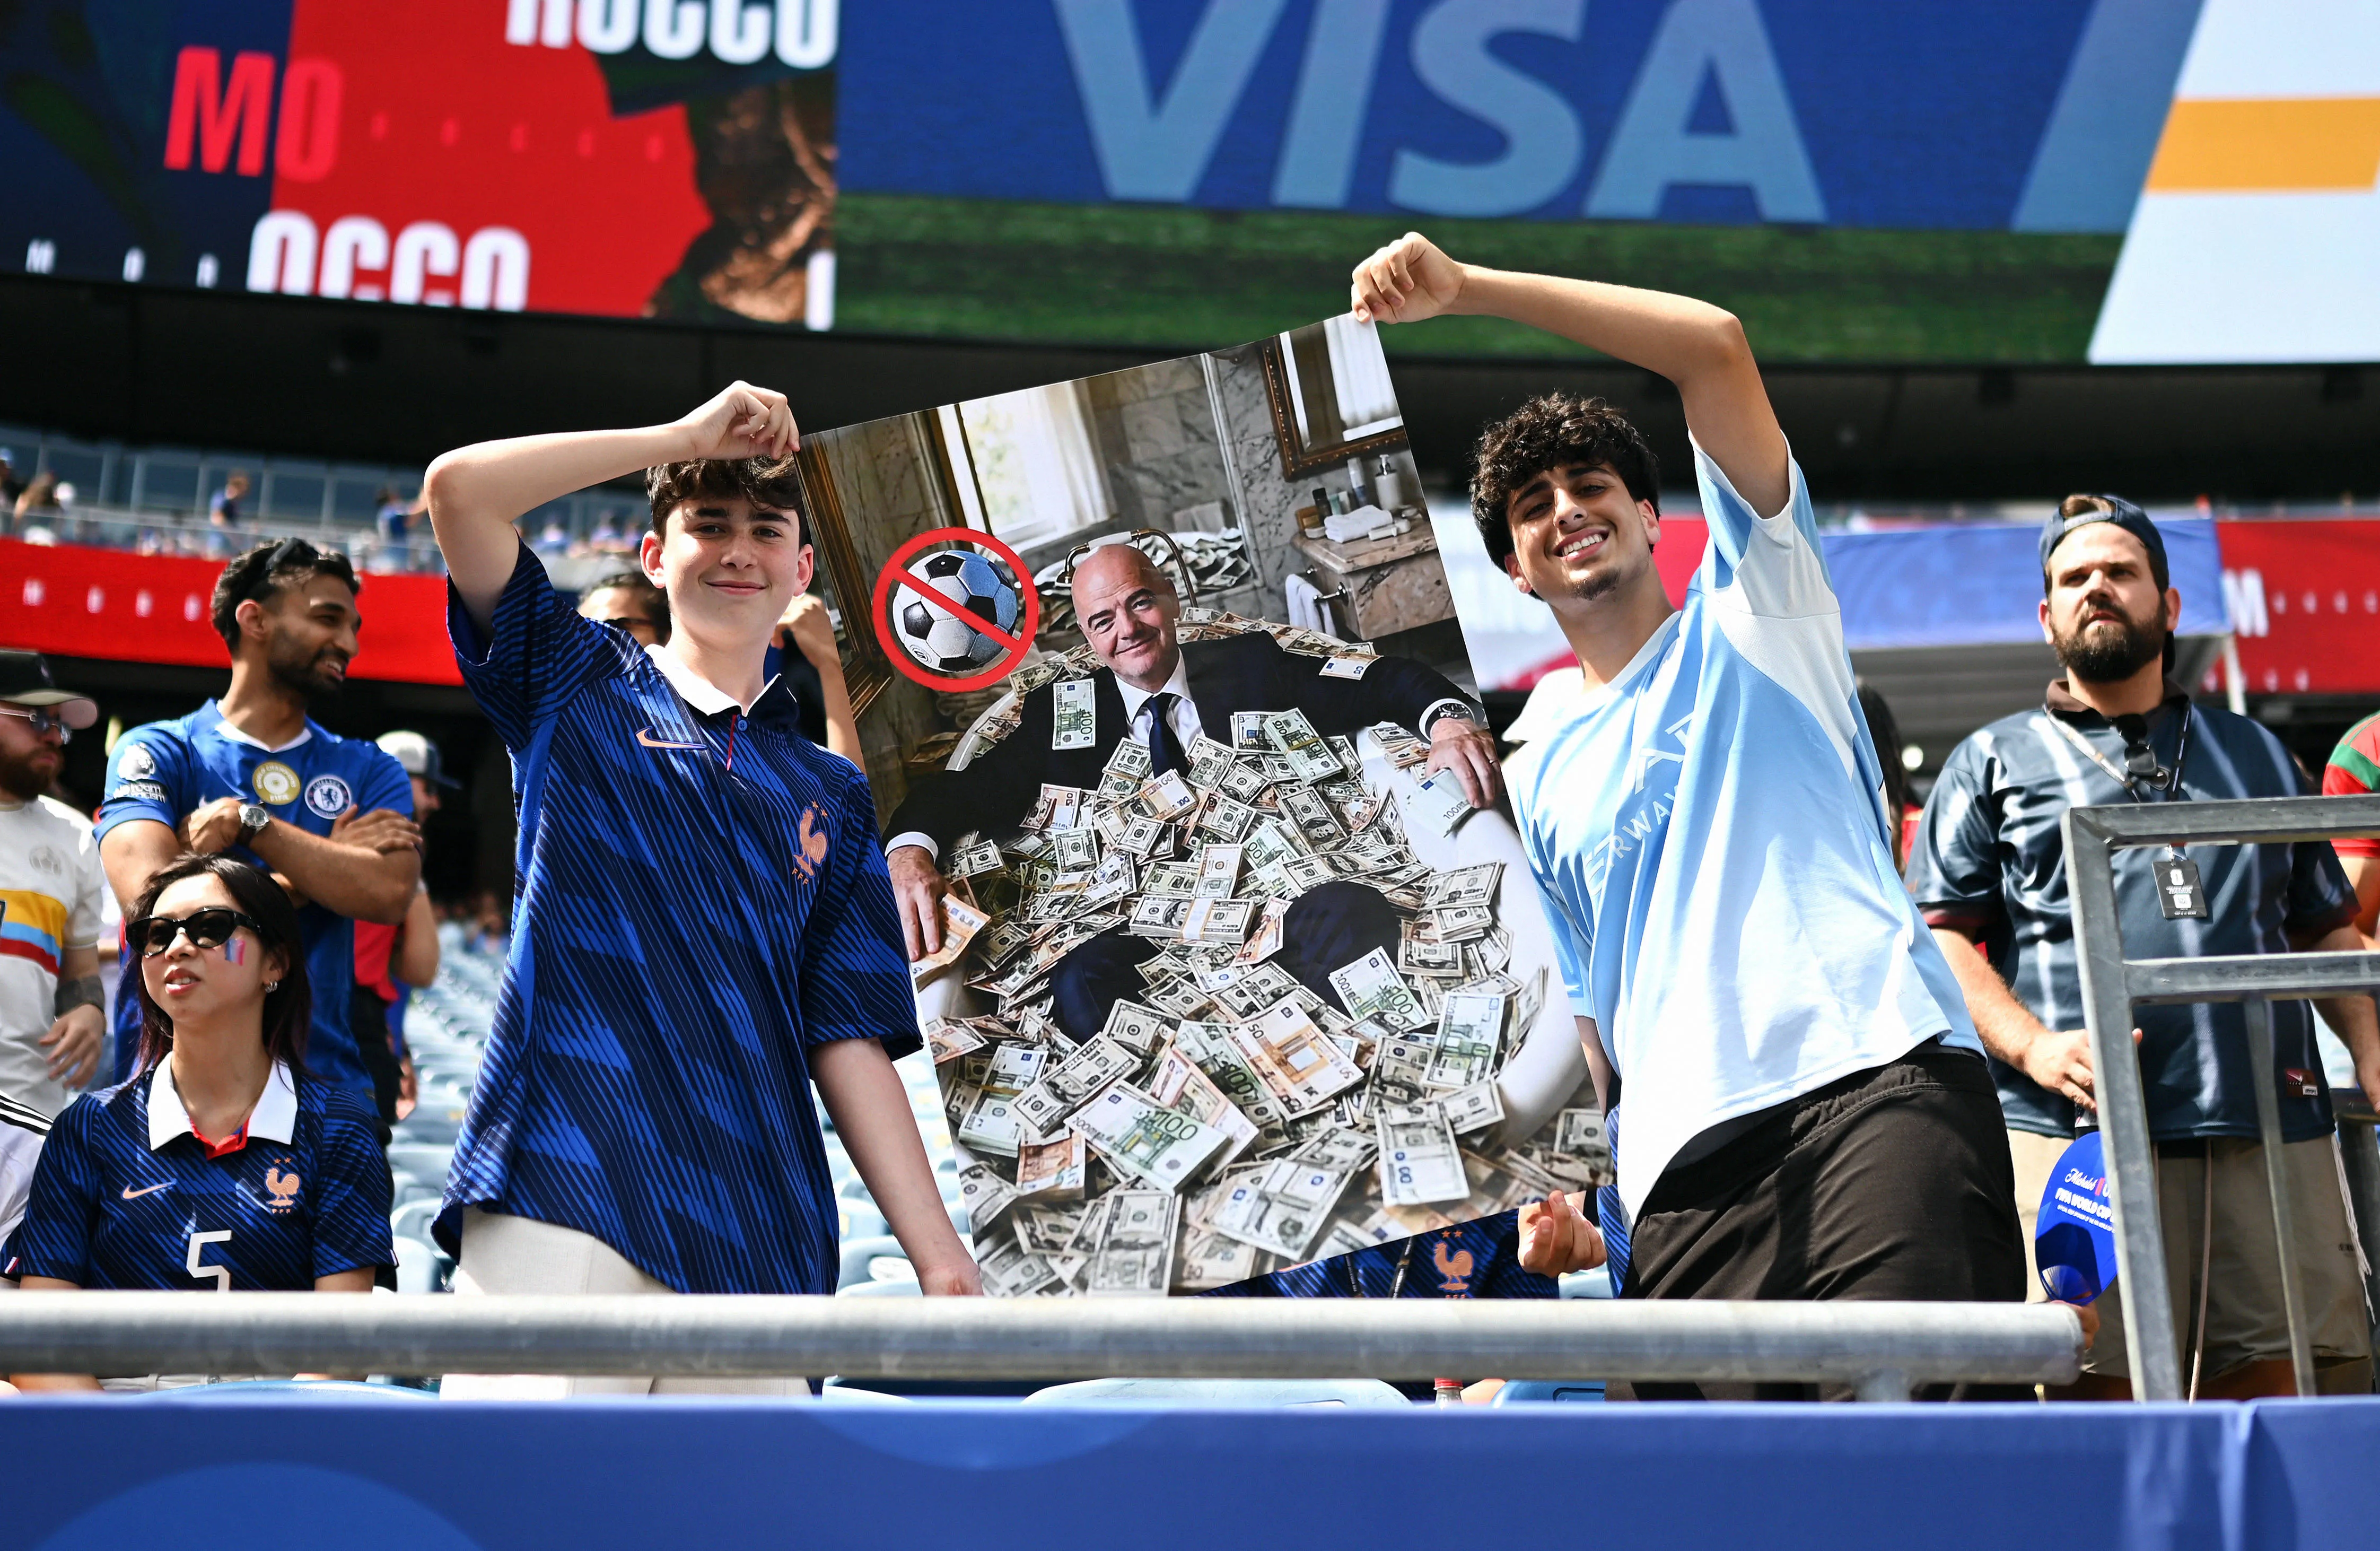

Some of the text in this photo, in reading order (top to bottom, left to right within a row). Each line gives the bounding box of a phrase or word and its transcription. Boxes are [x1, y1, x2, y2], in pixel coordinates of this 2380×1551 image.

[164, 46, 344, 182] MO
[1056, 0, 1827, 221] VISA
[2055, 1187, 2112, 1220] FIFA WORLD CUP
[186, 1229, 232, 1292] 5
